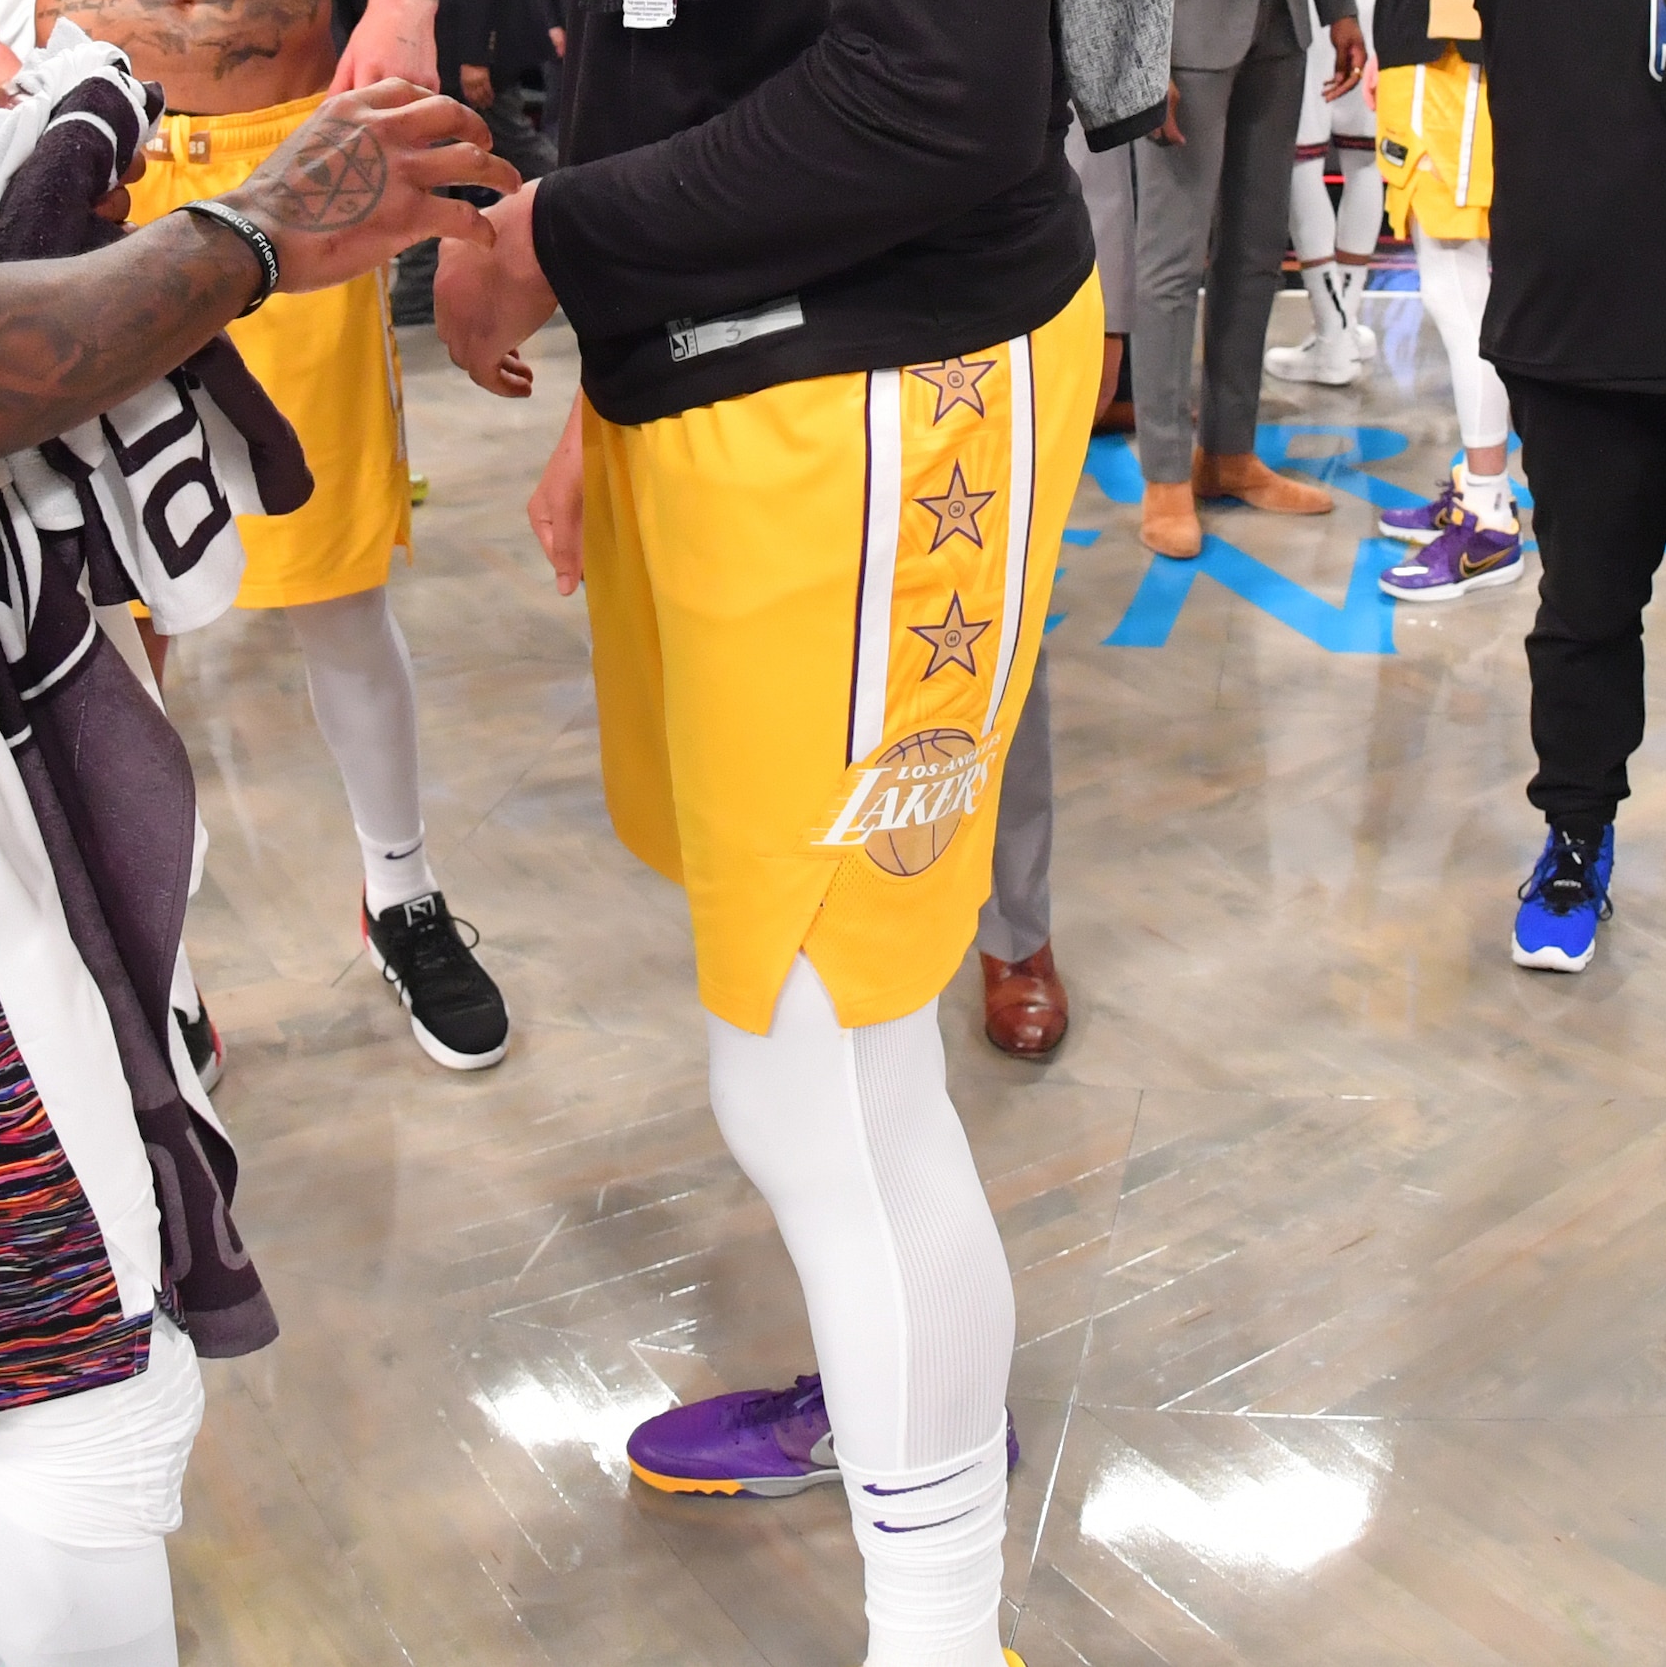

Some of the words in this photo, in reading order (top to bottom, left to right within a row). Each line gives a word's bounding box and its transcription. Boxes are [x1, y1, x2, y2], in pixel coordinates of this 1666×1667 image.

[896, 762, 939, 781] LOS
[940, 731, 1002, 775] ANGELES
[810, 751, 998, 846] LAKERS
